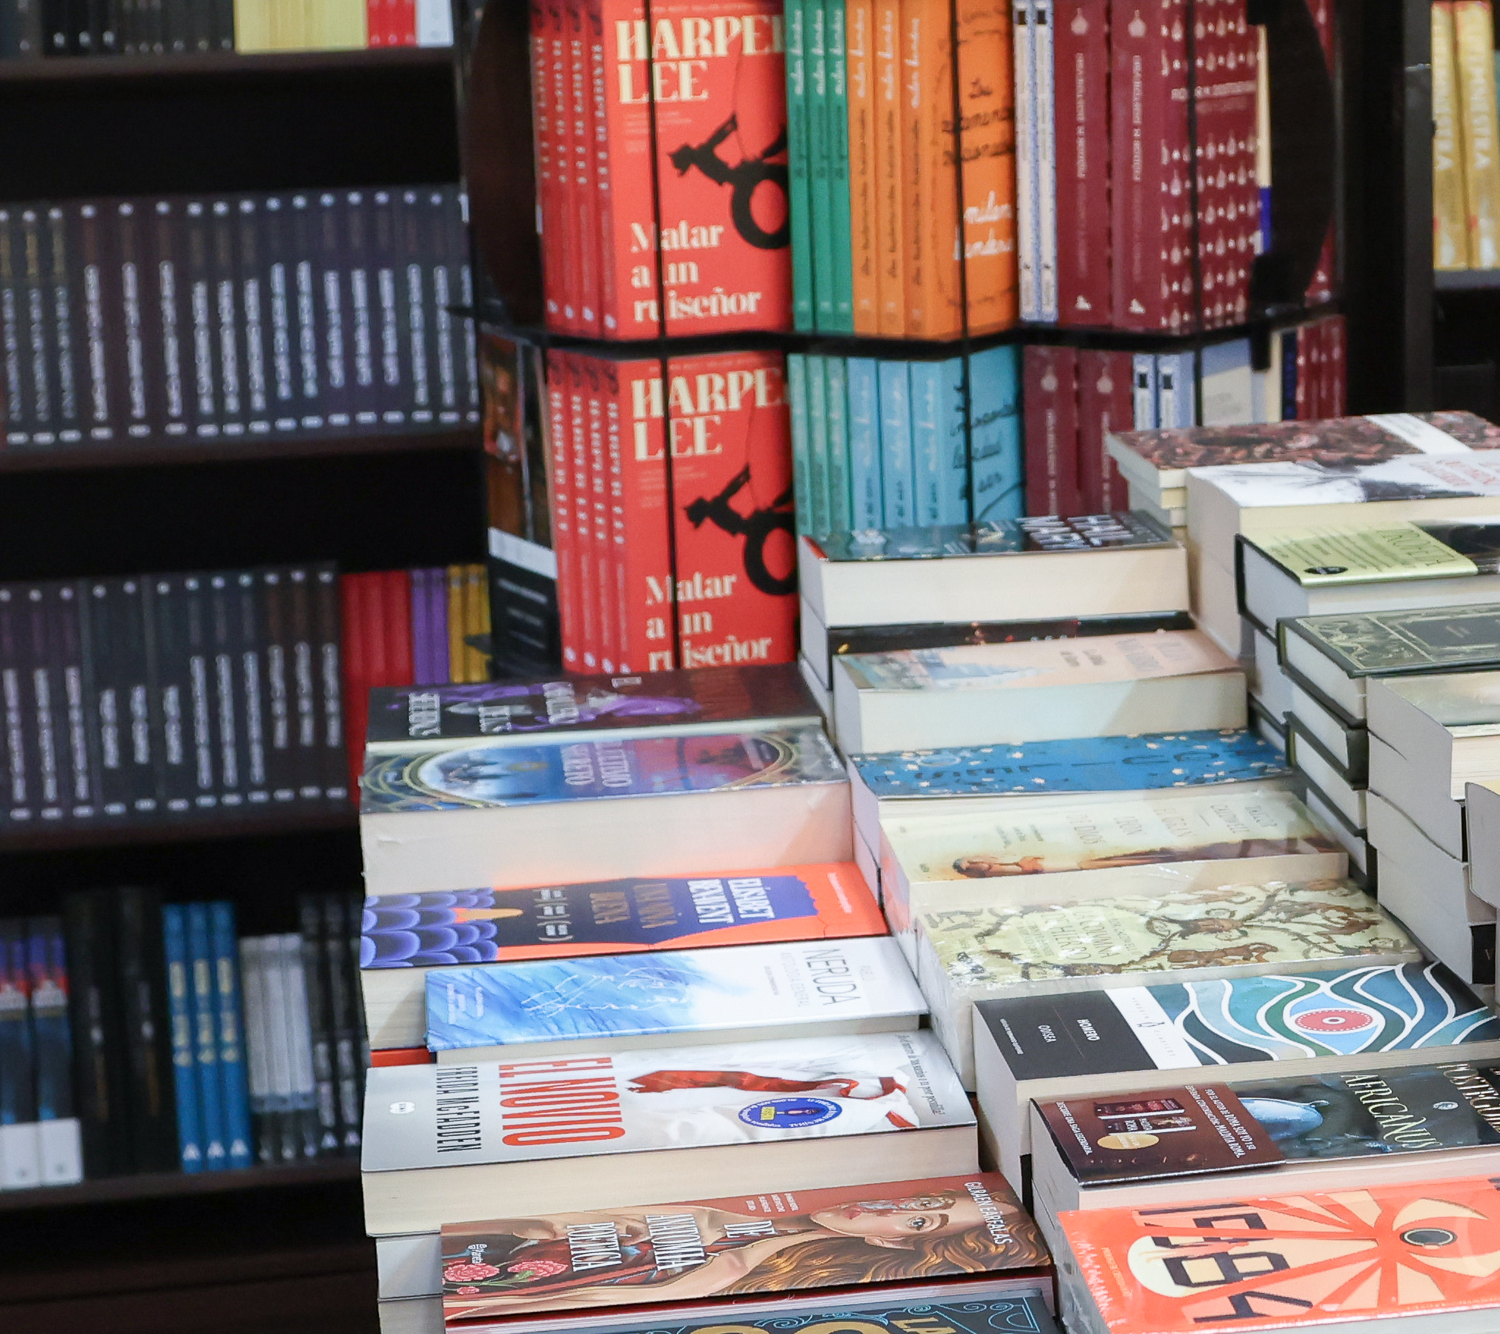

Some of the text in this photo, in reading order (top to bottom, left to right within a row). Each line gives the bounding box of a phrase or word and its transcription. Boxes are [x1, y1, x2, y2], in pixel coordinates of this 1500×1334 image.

[618, 61, 708, 104] LEE
[631, 220, 724, 252] Matar
[803, 948, 861, 1007] NERUDA
[1076, 1018, 1100, 1042] HOMERO
[436, 1096, 482, 1153] McFADDEN
[499, 1057, 626, 1147] EL NOVIO
[1342, 1074, 1443, 1149] AFRICANUS
[965, 1181, 996, 1210] GILRAEN
[645, 1214, 717, 1270] ANATOMÍA
[724, 1220, 777, 1239] DE
[1132, 1200, 1314, 1325] 1984
